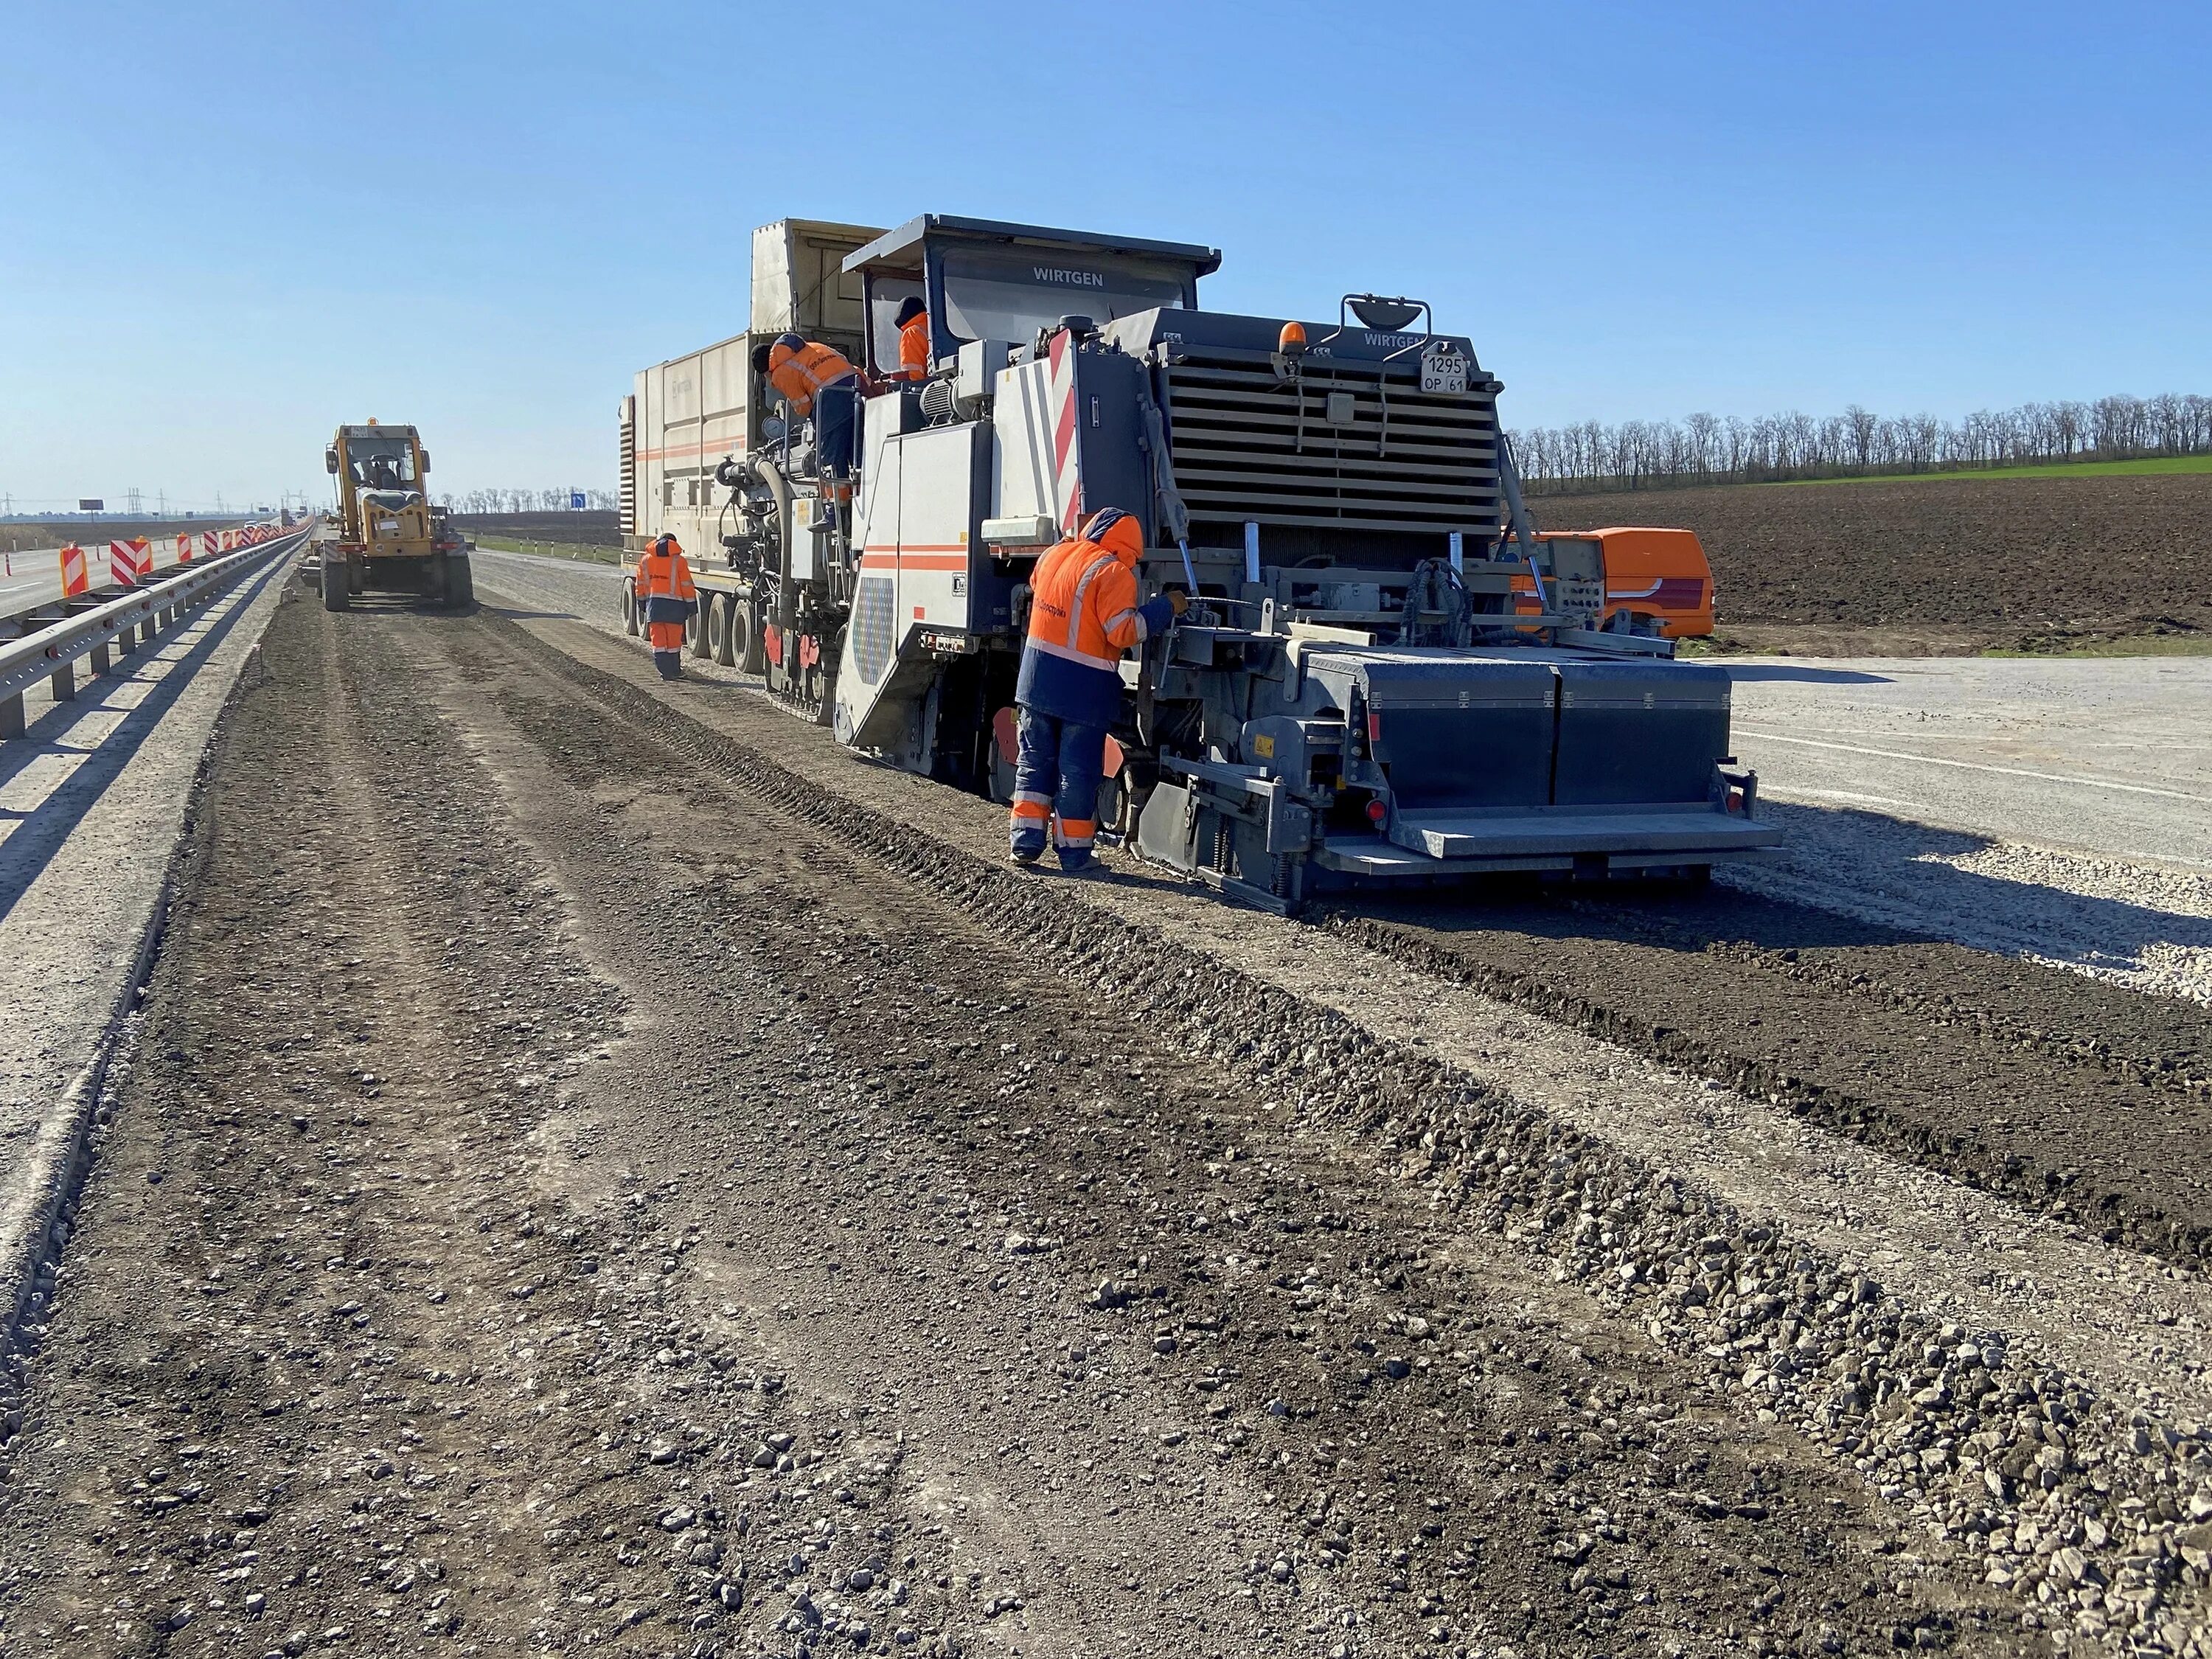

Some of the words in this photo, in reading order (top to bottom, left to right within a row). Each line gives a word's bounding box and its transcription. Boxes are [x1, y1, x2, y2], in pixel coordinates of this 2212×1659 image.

[1034, 267, 1103, 287] WIRTGEN
[1429, 357, 1462, 374] 1295
[1450, 379, 1464, 392] 61
